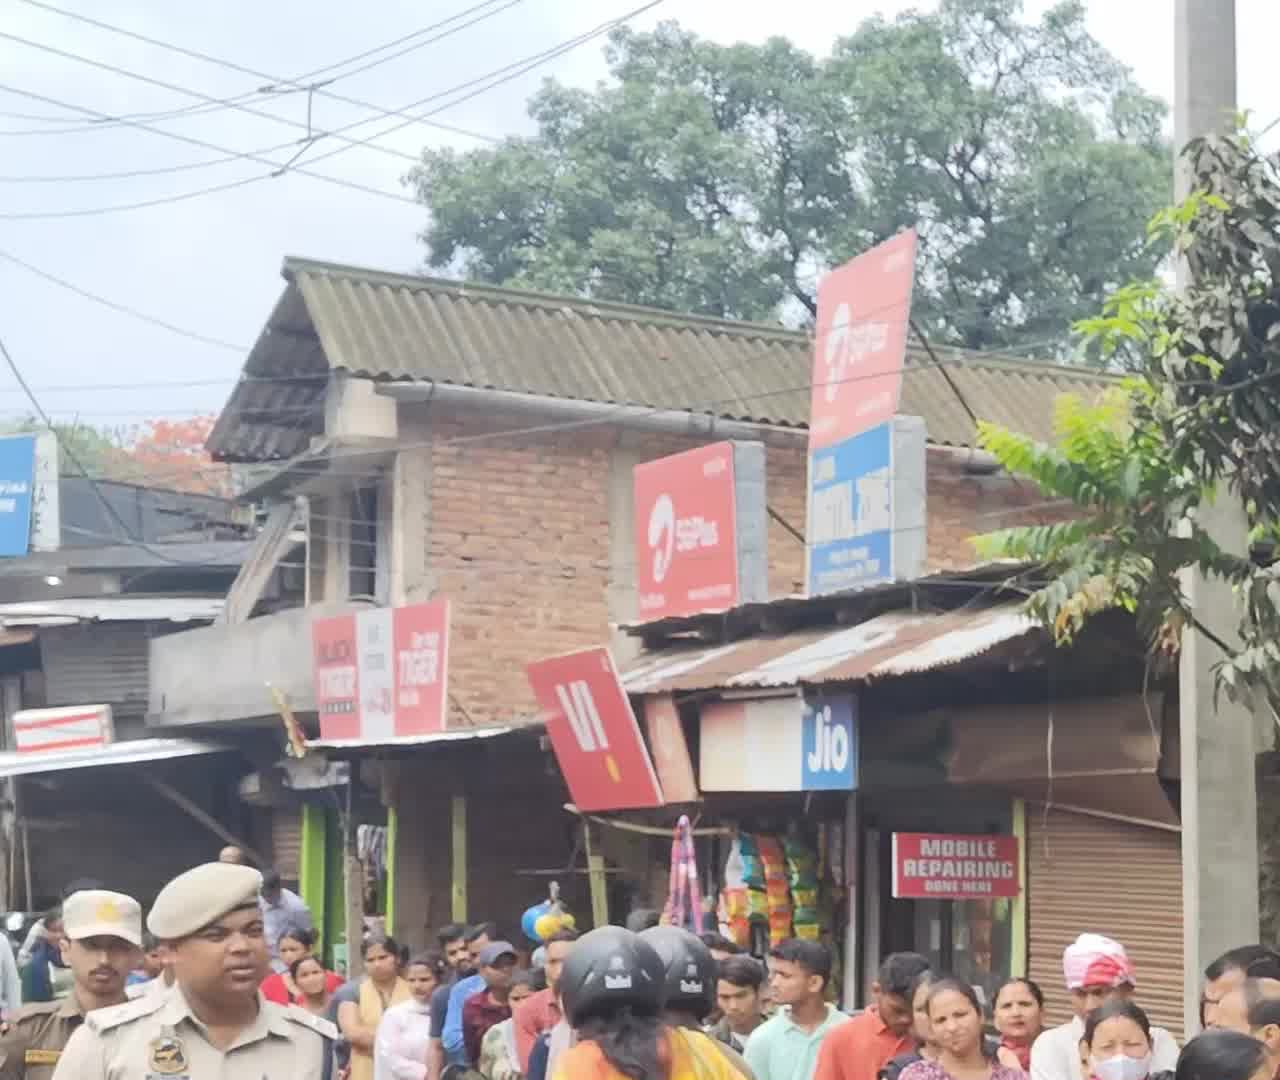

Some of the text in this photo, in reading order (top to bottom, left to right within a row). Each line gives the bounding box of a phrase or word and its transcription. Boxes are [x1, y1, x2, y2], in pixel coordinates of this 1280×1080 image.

[807, 704, 849, 773] Jio
[920, 838, 997, 857] MOBILE
[903, 859, 1014, 879] REPAIRING
